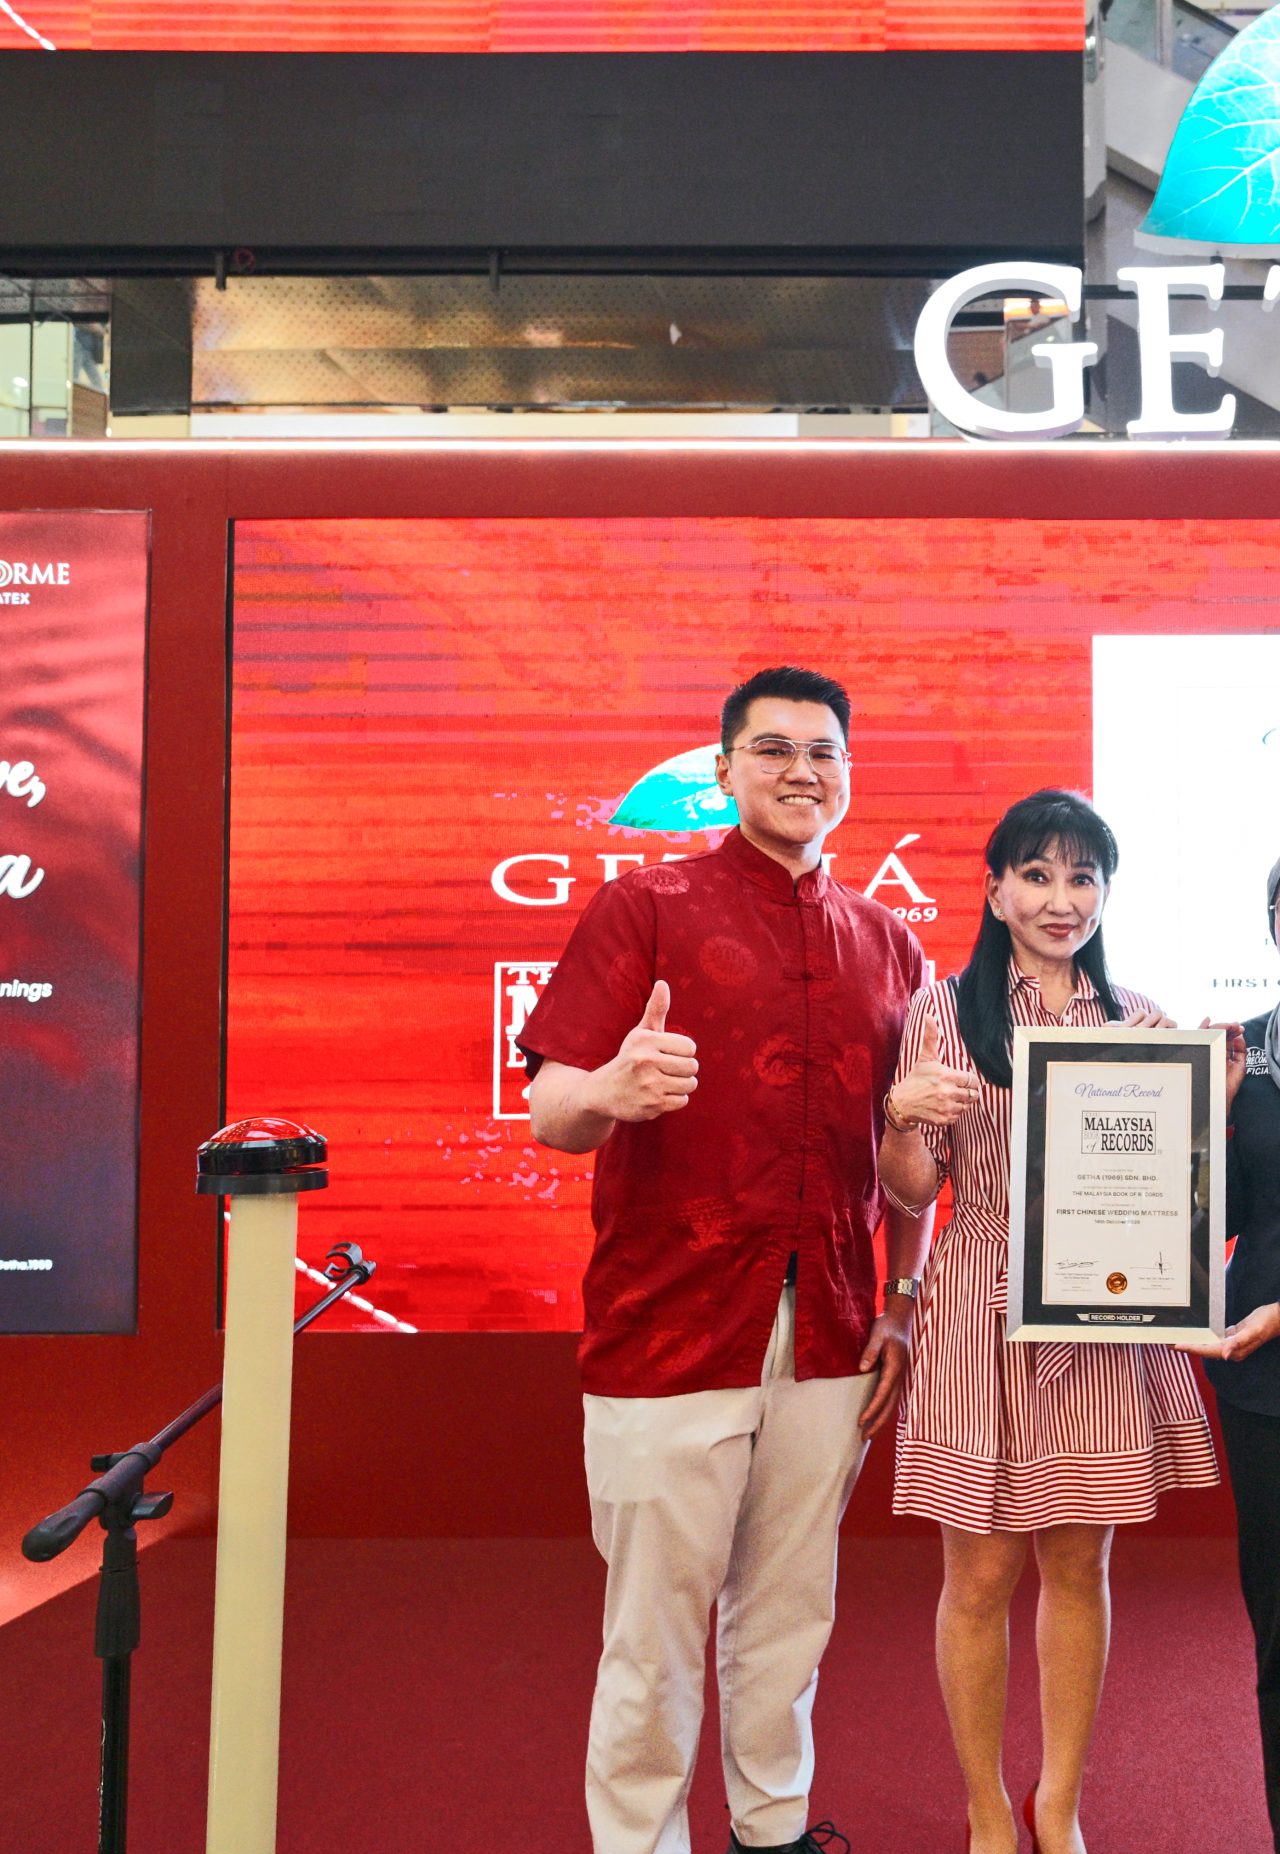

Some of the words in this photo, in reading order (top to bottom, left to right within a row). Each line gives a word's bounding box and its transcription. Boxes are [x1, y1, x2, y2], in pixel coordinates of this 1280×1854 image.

[892, 906, 938, 922] 969
[1213, 978, 1268, 988] FIRST
[1246, 1067, 1269, 1075] FICIA
[1074, 1083, 1123, 1098] National
[1123, 1084, 1164, 1098] Record
[1084, 1117, 1153, 1131] MALAYSIA
[1101, 1133, 1154, 1151] RECORDS
